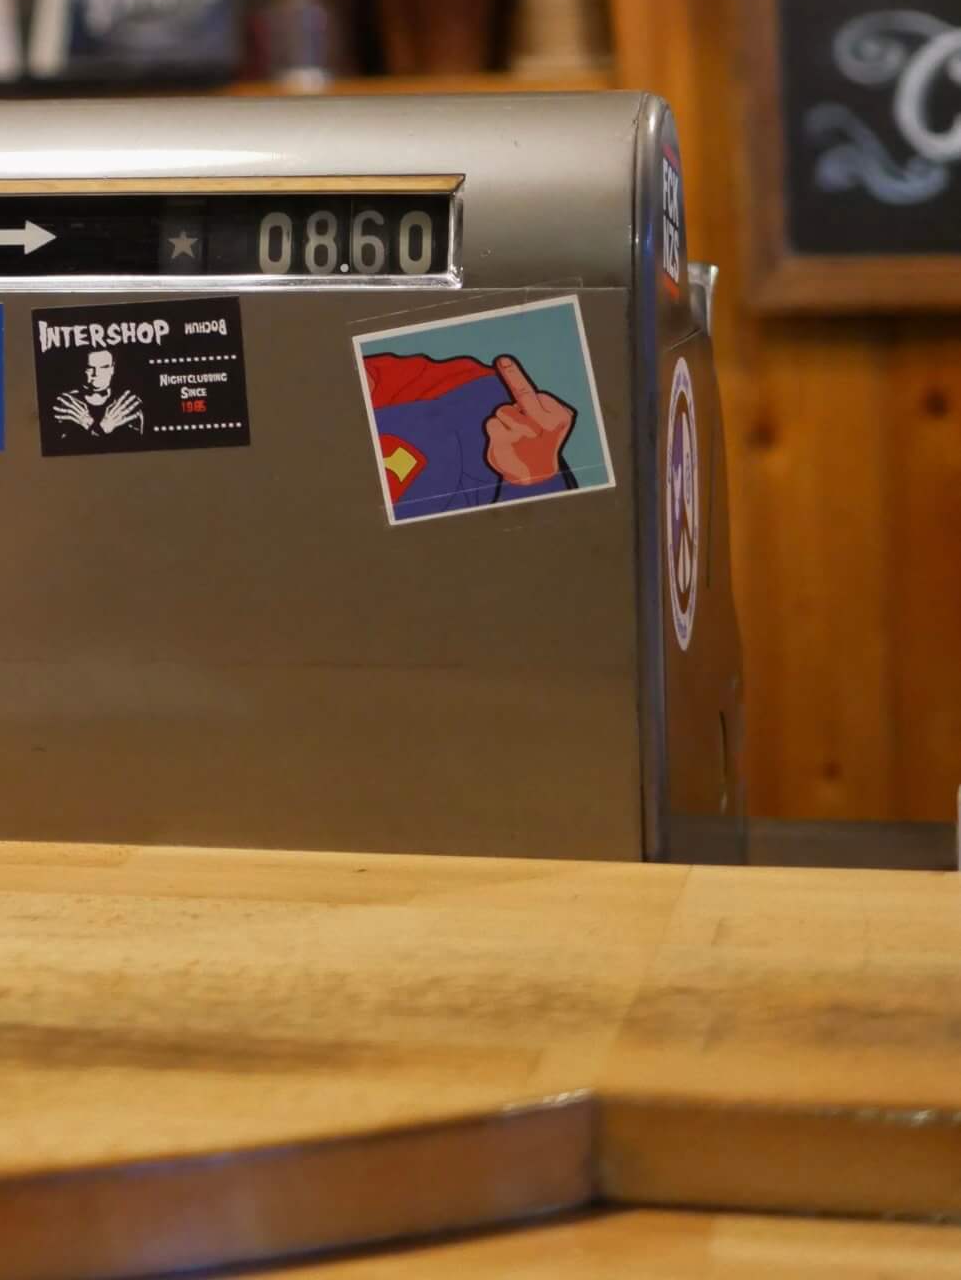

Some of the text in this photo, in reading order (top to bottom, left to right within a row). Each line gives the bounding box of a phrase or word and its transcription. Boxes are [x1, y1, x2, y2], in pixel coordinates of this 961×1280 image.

[662, 157, 680, 227] FCK
[662, 215, 680, 283] NZS
[38, 319, 170, 352] INTERSHOP
